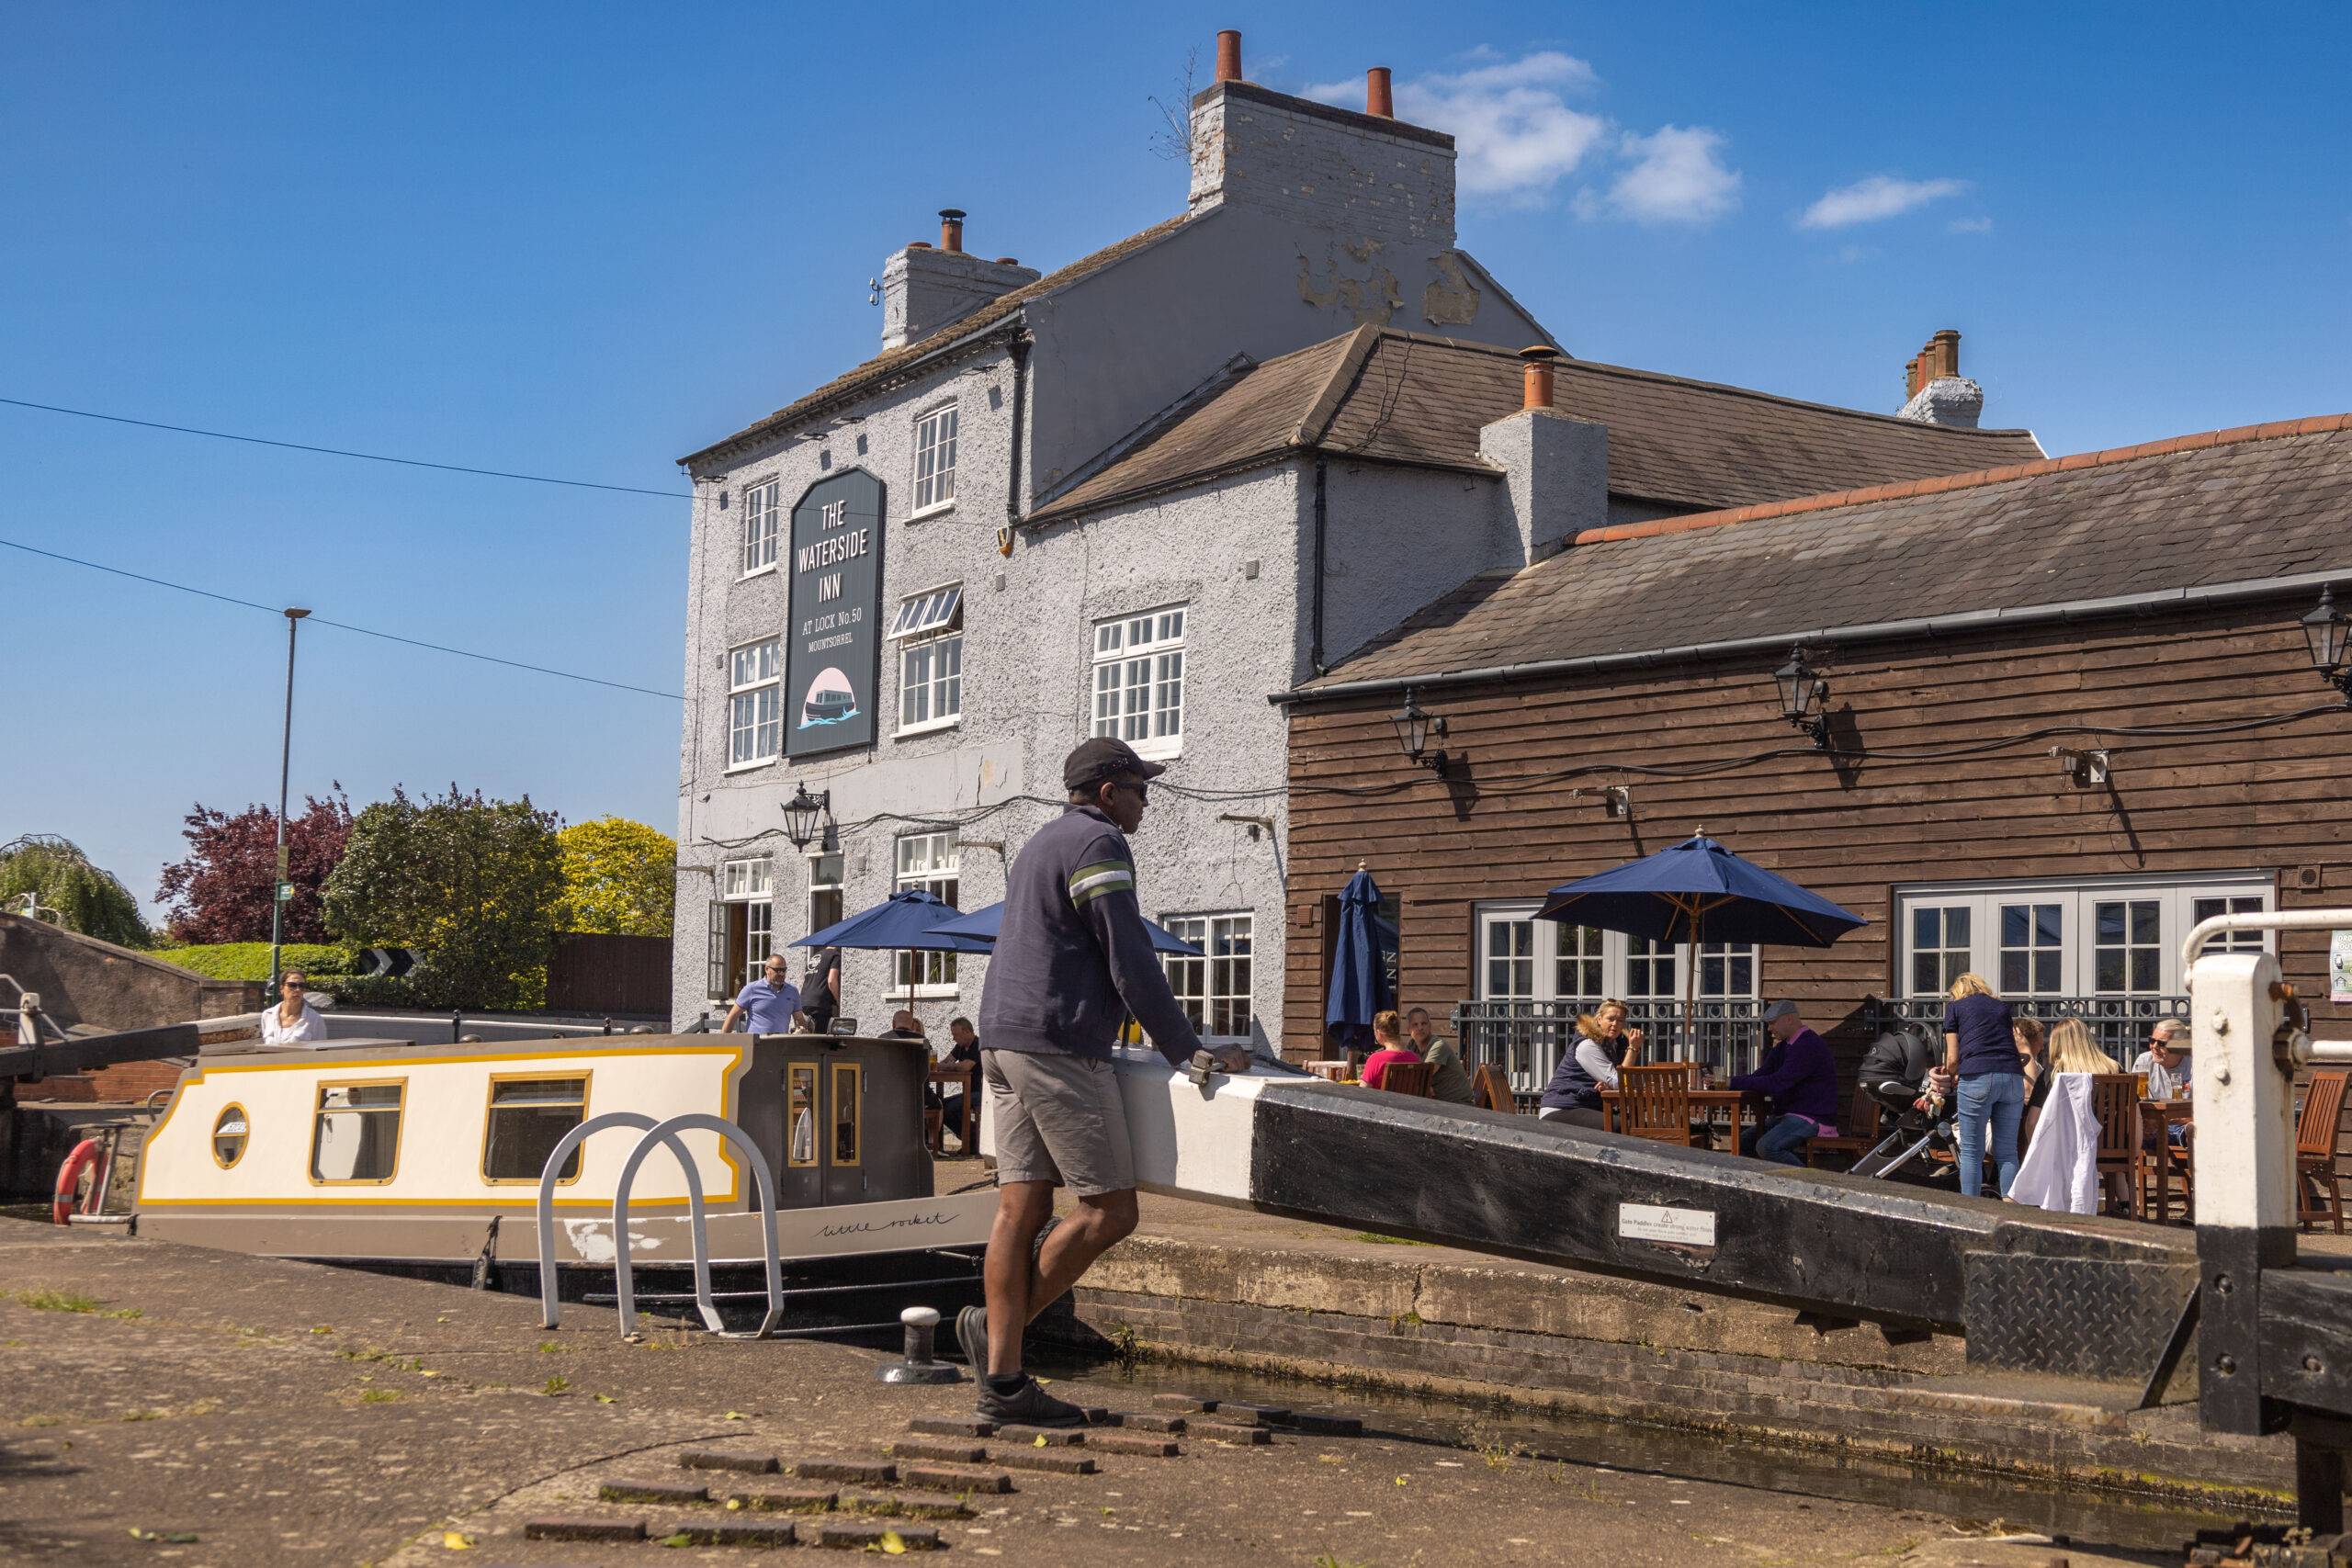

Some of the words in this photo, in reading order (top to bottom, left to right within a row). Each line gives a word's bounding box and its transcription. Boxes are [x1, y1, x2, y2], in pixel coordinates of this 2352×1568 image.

[822, 500, 845, 530] THE
[798, 528, 868, 573] WATERSIDE
[819, 572, 841, 603] INN
[802, 620, 813, 636] AT
[815, 615, 835, 632] LOCK
[808, 632, 853, 652] MOUNTSORREL
[810, 1223, 877, 1237] little
[888, 1213, 960, 1227] rocket
